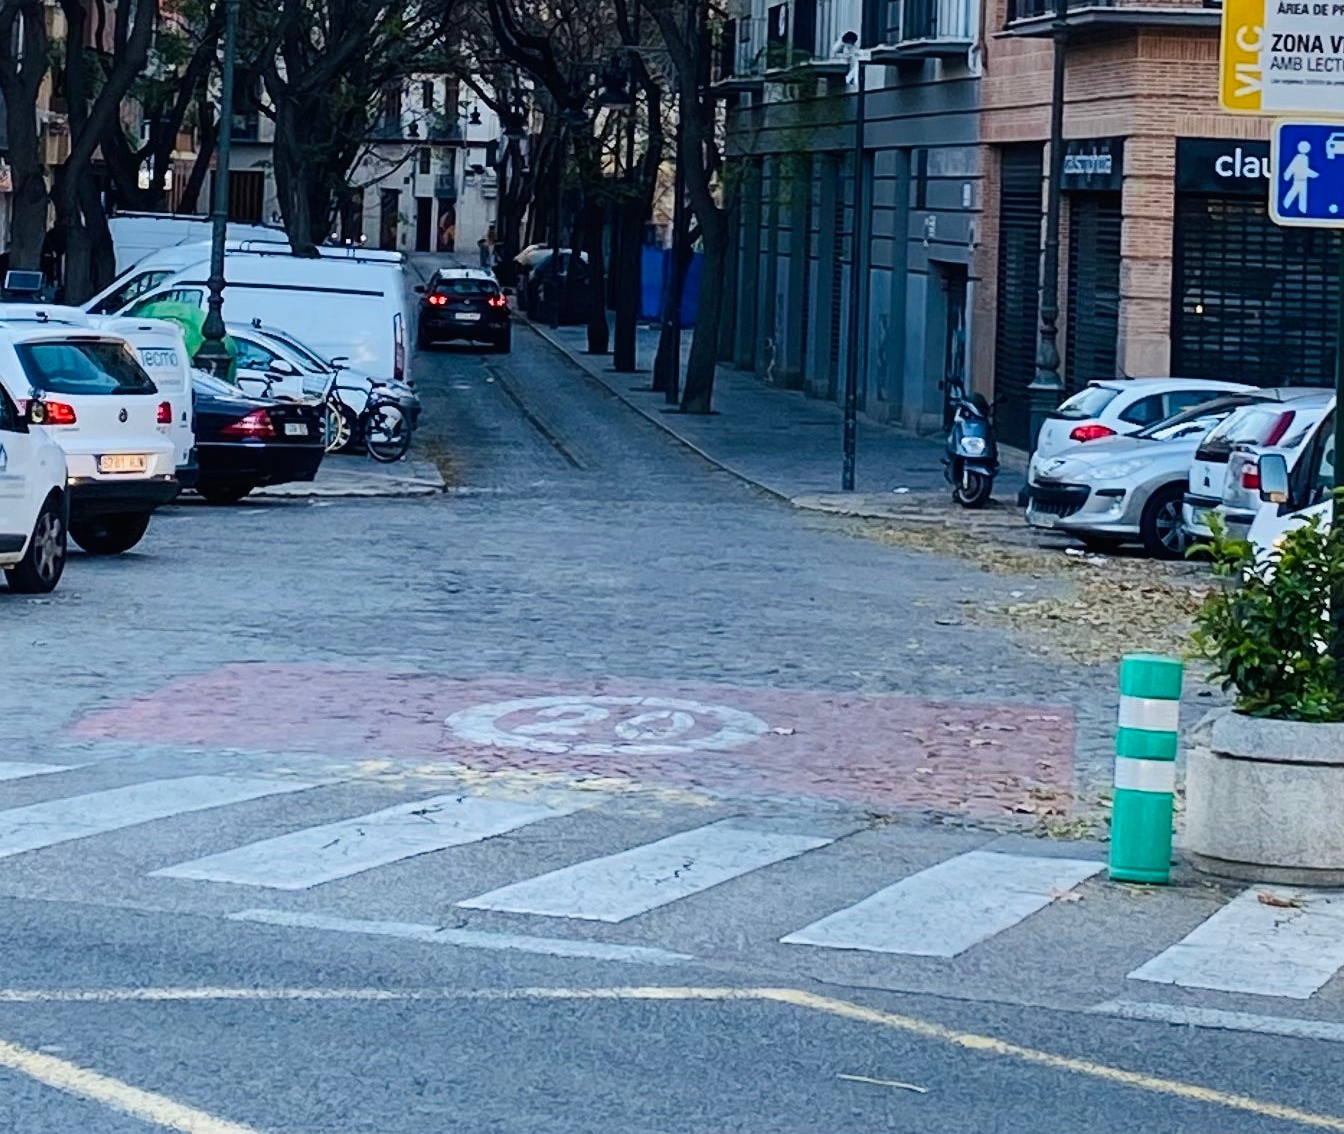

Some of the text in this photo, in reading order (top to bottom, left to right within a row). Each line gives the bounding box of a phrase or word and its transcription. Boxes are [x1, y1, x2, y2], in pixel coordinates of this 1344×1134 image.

[1313, 3, 1328, 15] DE
[1271, 34, 1324, 53] ZONA
[1270, 56, 1302, 71] AMB
